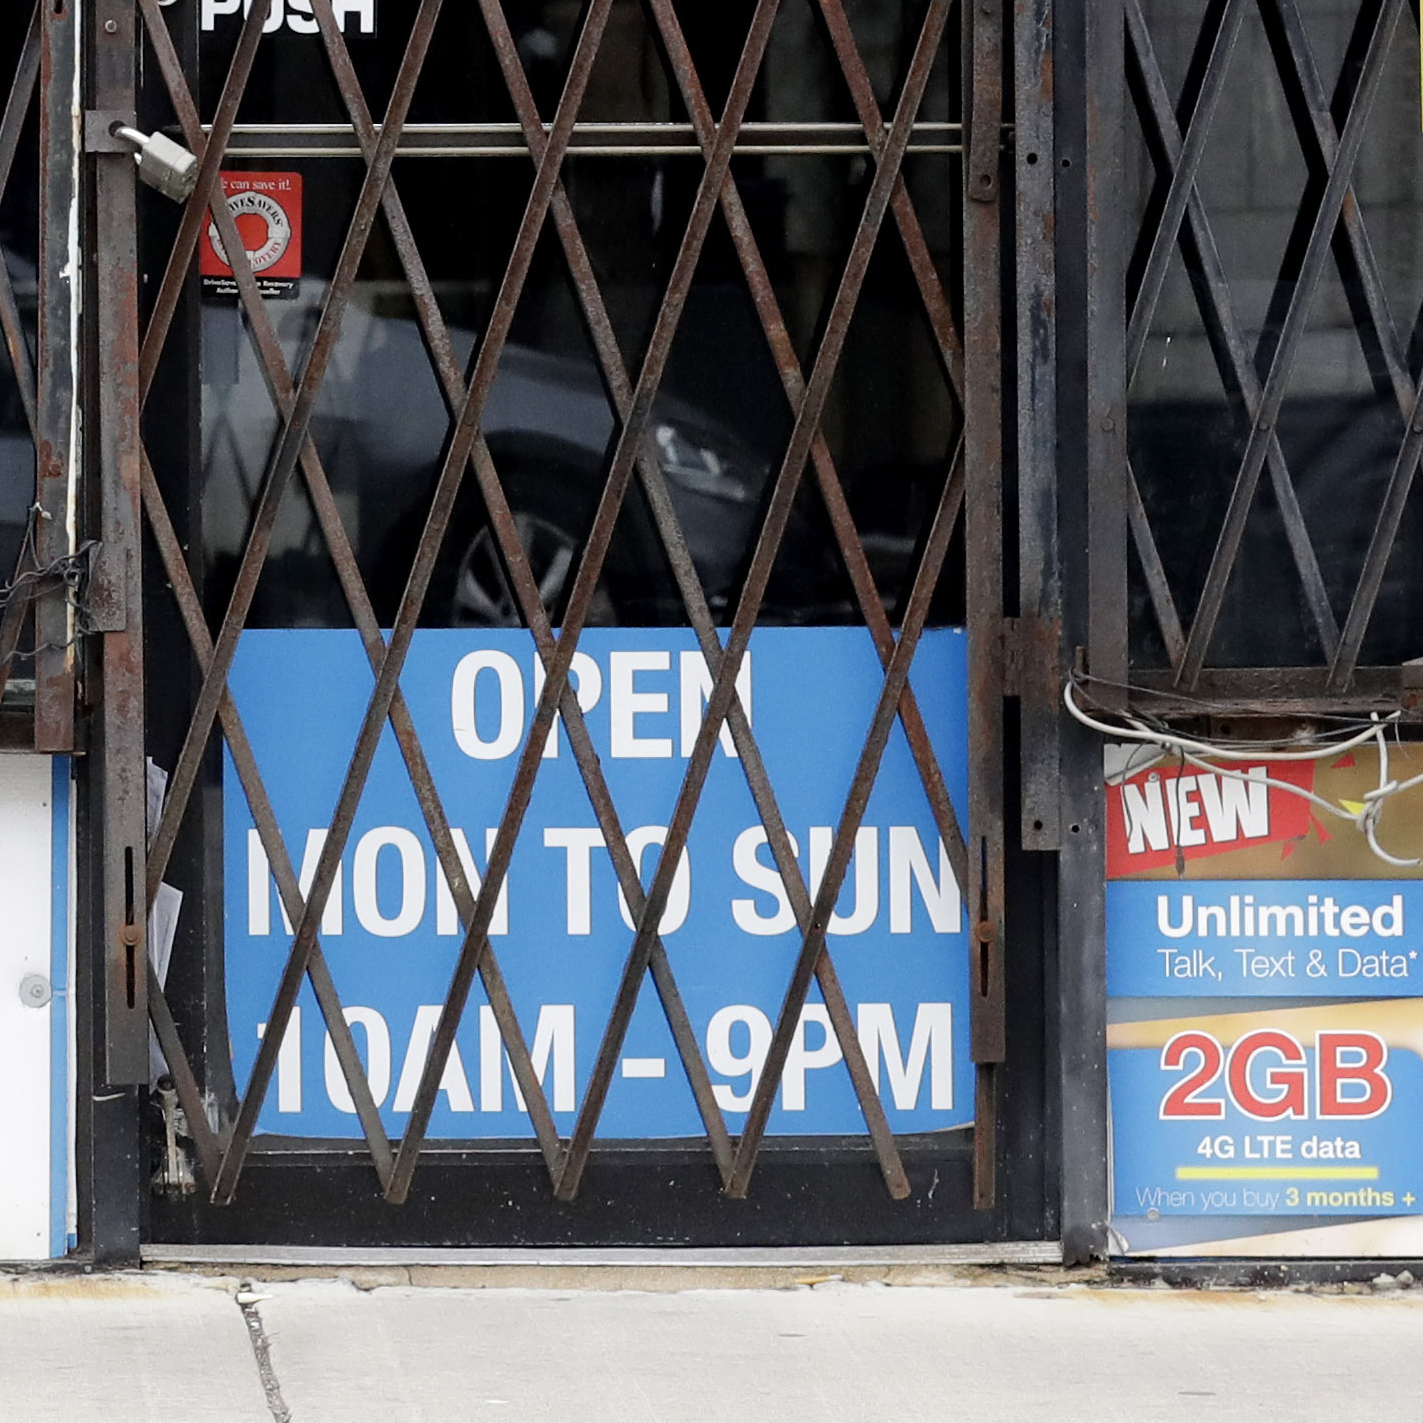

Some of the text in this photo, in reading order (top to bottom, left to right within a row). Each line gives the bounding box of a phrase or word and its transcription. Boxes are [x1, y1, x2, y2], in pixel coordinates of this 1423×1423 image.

[230, 179, 251, 189] can
[252, 179, 275, 190] save
[452, 649, 754, 761] OPEN
[1122, 766, 1272, 855] NEW
[246, 825, 962, 938] MON TO SUN
[1156, 893, 1405, 937] Unlimited
[1157, 949, 1223, 982] Talk,
[1234, 949, 1296, 978] Text
[1305, 950, 1328, 978] &
[256, 1002, 577, 1115] 10AM
[705, 1002, 955, 1115] 9PM
[1159, 1028, 1393, 1121] 2GB
[1197, 1135, 1362, 1160] 4G LTE data
[1135, 1185, 1417, 1213] When you buy 3 months +
